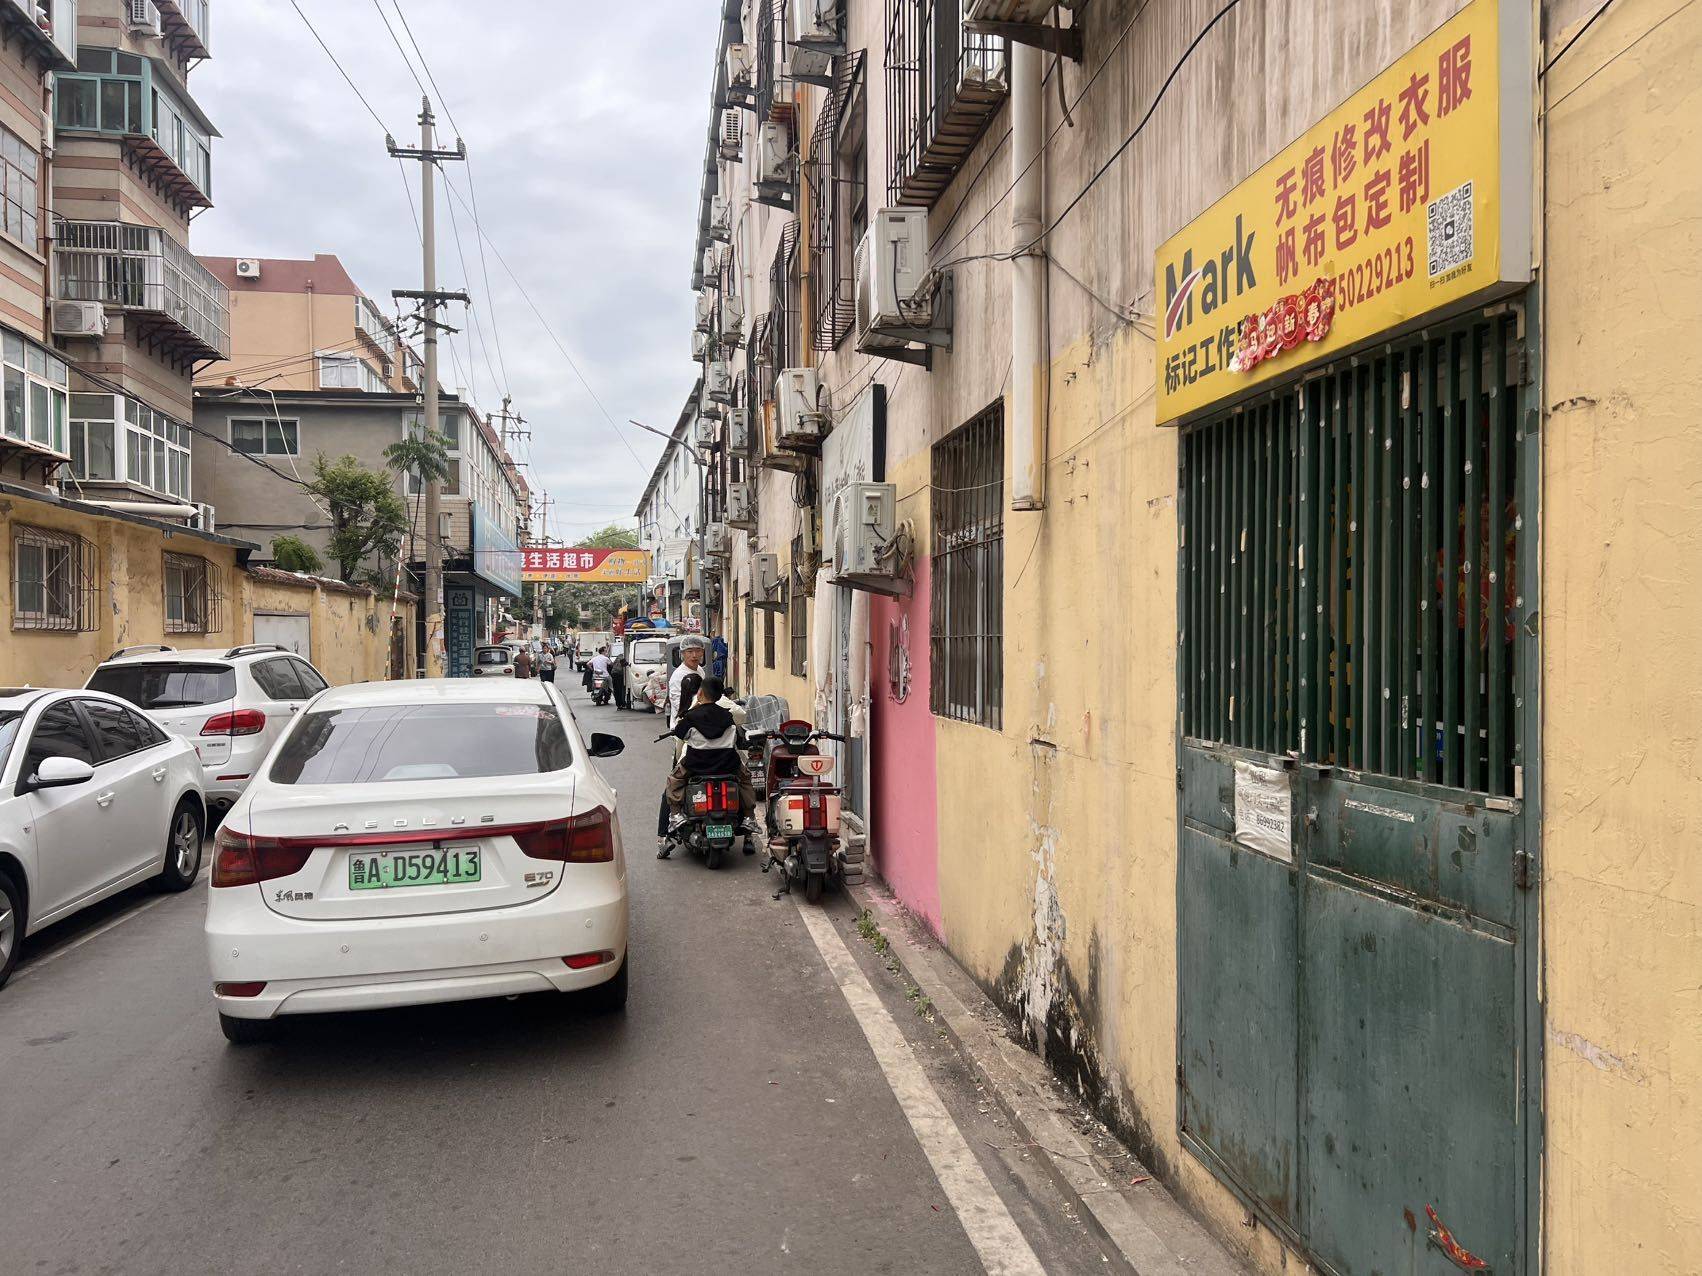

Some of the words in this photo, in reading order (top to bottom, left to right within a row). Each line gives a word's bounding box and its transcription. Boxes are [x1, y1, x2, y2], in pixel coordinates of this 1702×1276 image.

[1275, 33, 1473, 229] 无痕修改衣服
[1274, 138, 1431, 287] 帆布包定制
[1165, 214, 1257, 339] Mark
[1164, 320, 1247, 395] 标记工作
[333, 814, 495, 832] AEOLUS
[524, 871, 553, 882] E70
